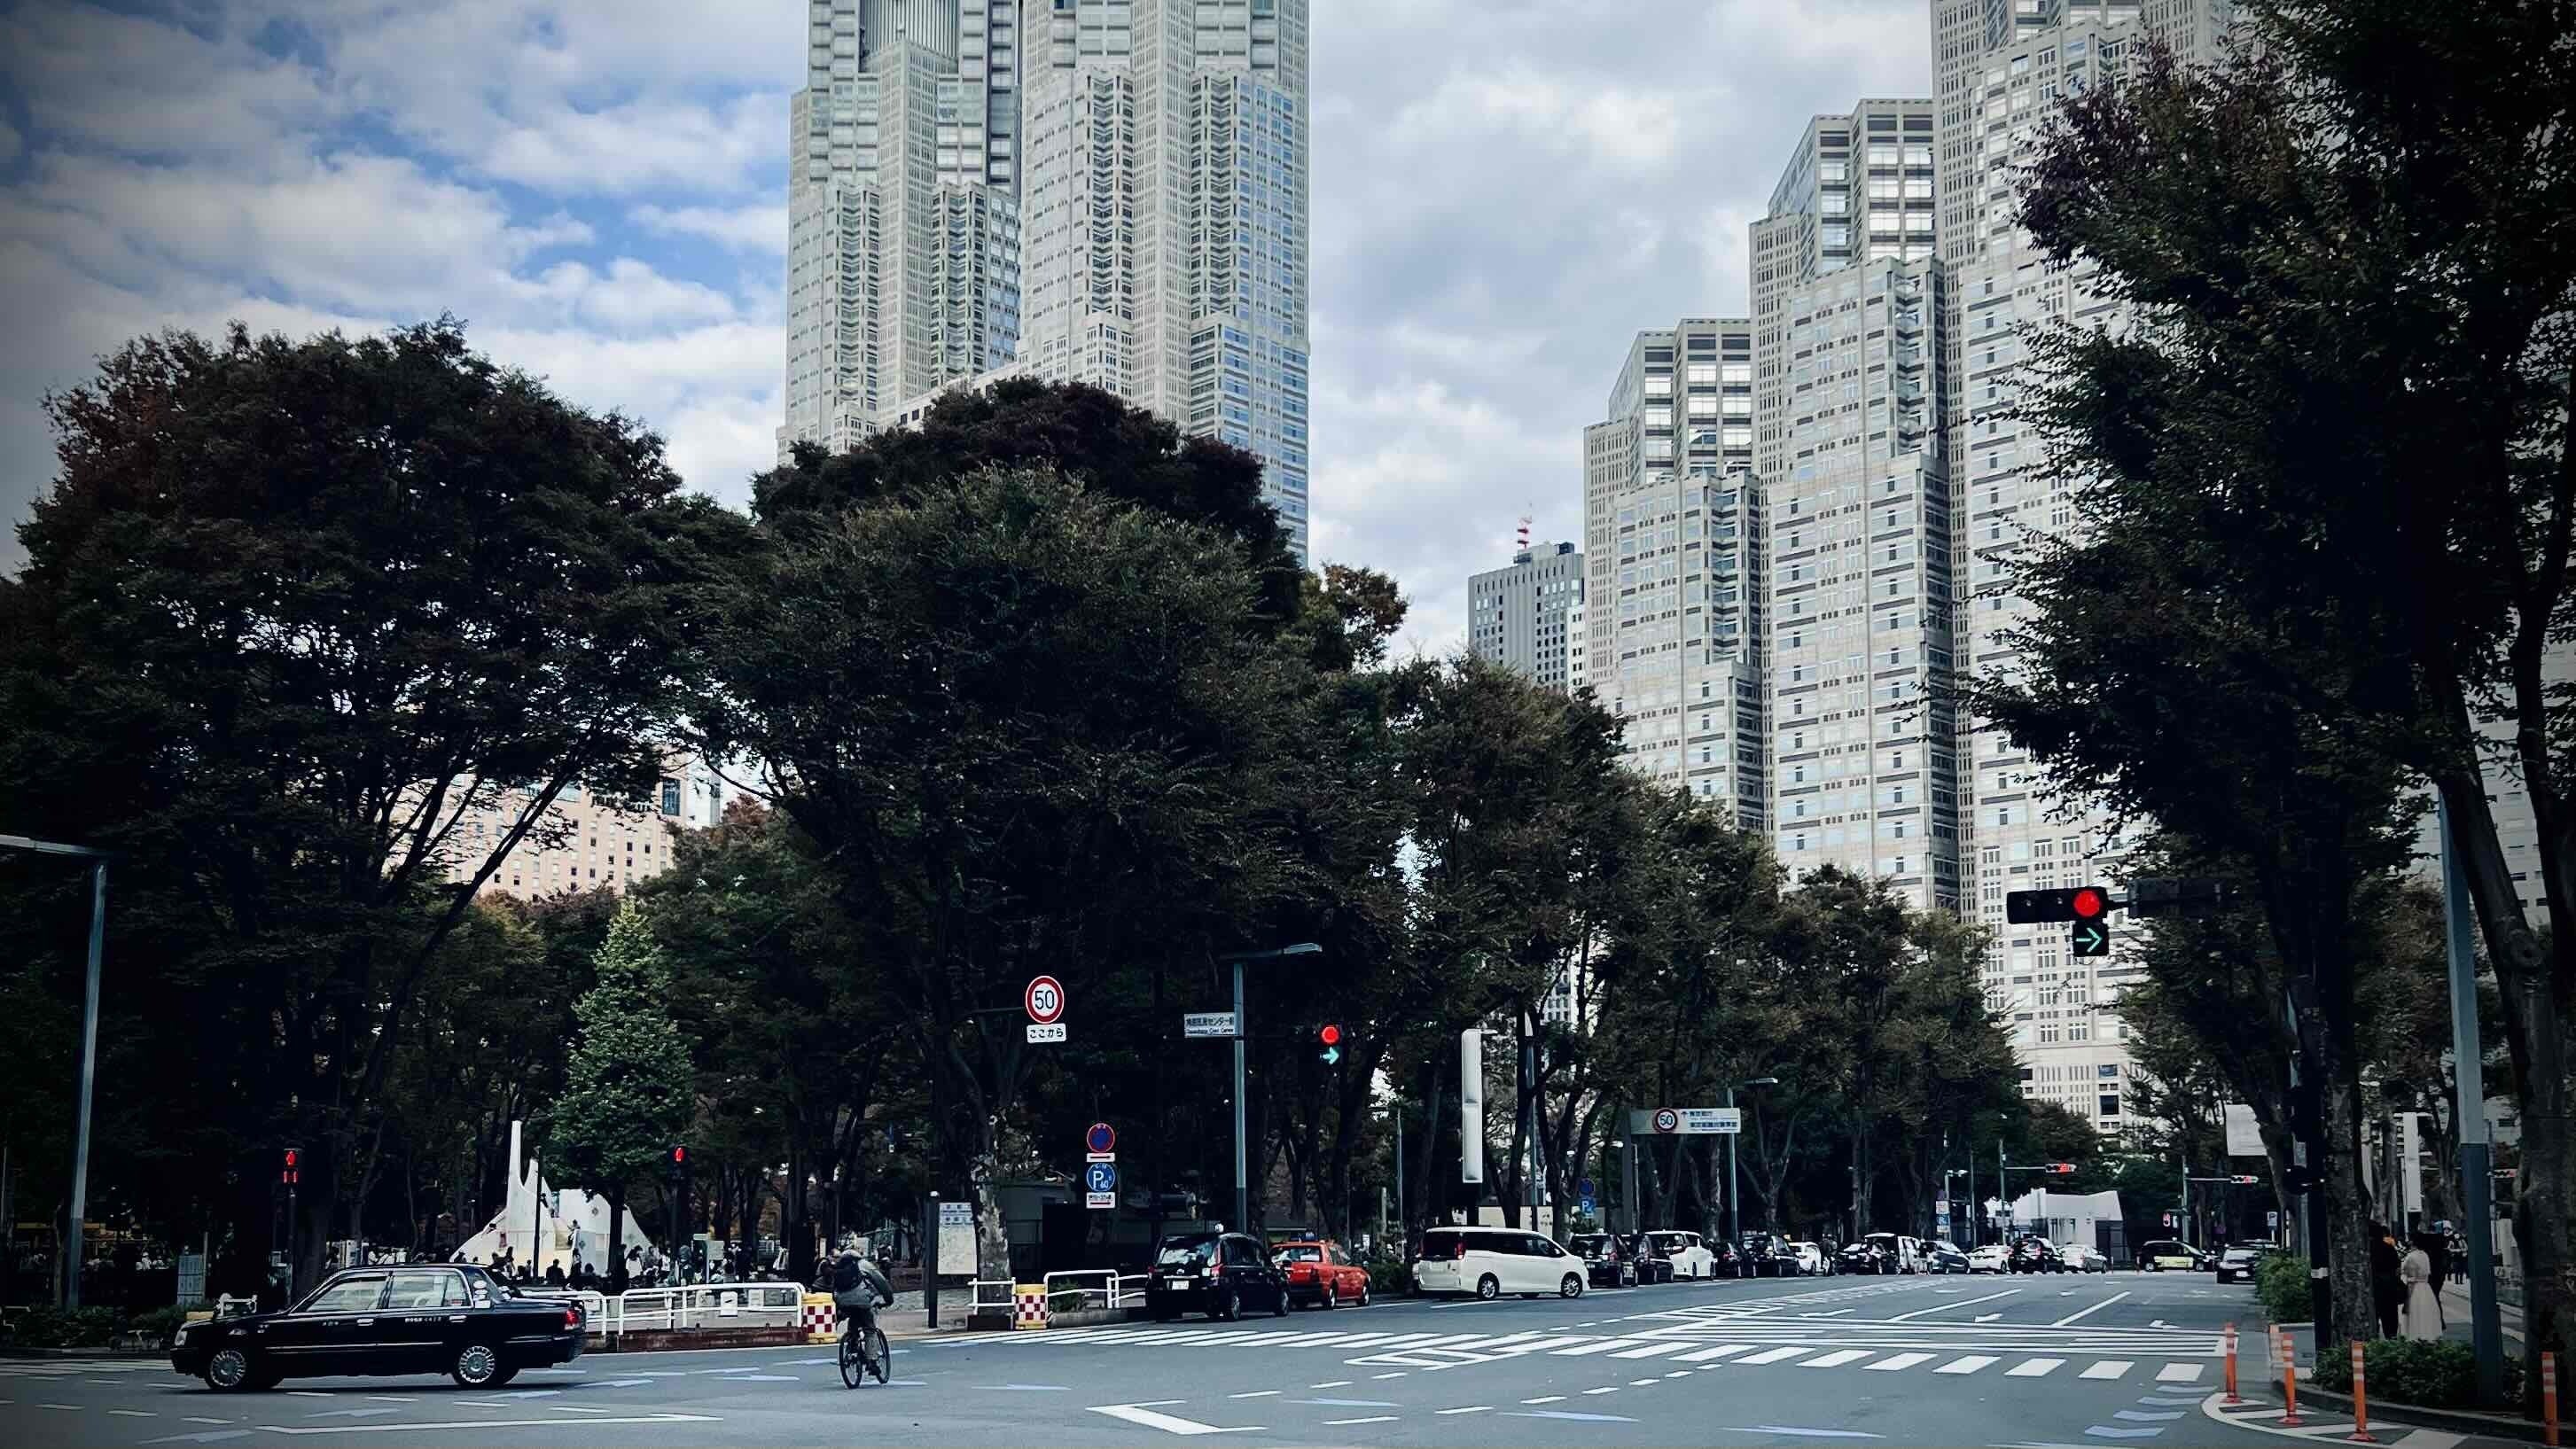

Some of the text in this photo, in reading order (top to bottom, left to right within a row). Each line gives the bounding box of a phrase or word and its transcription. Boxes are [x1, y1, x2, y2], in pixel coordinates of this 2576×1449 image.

[1035, 990, 1054, 1009] 50
[1030, 1028, 1064, 1038] ここから
[1659, 1115, 1674, 1126] 50
[1093, 1171, 1105, 1190] P
